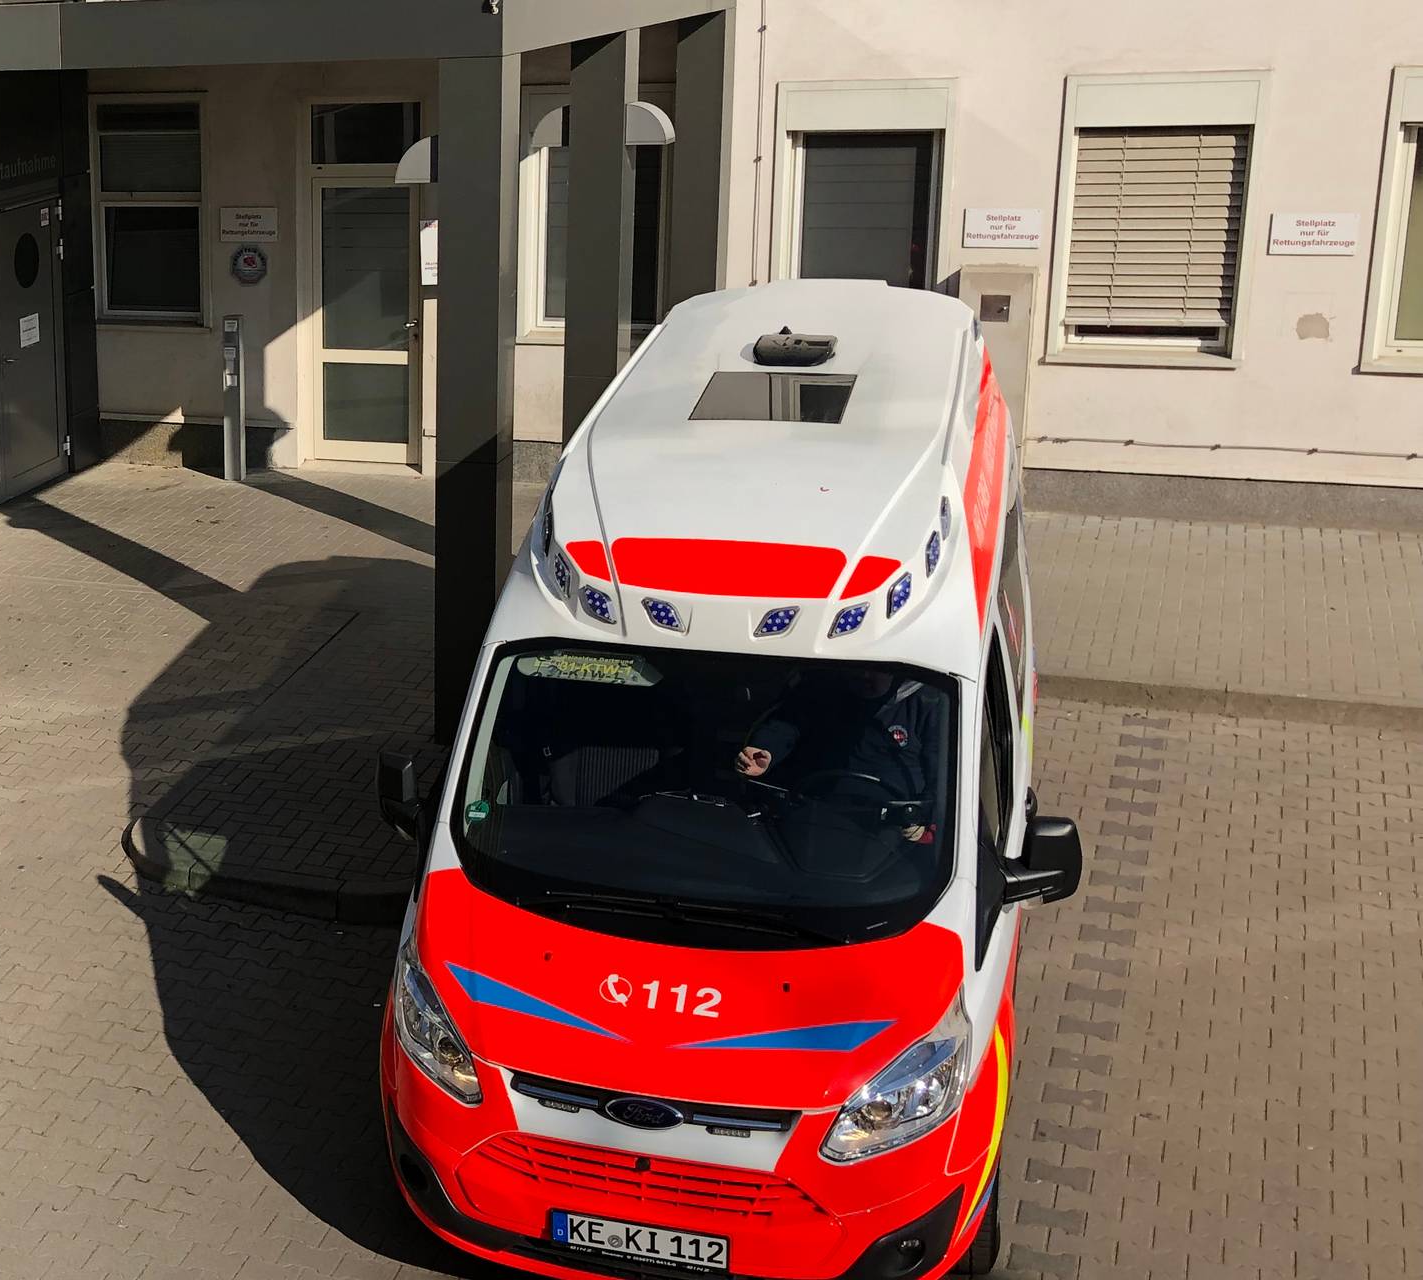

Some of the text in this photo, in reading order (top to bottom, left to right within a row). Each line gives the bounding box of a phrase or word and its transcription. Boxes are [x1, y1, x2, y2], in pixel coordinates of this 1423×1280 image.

[986, 214, 1021, 222] Stellplatz
[1295, 219, 1336, 227] Stellplatz
[966, 232, 1040, 240] Rettungsfahrzeuge
[1272, 239, 1355, 247] Rettungsfahrzeuge
[642, 980, 722, 1018] 112
[624, 1103, 668, 1124] Ford
[557, 1217, 724, 1264] D KE KI 112
